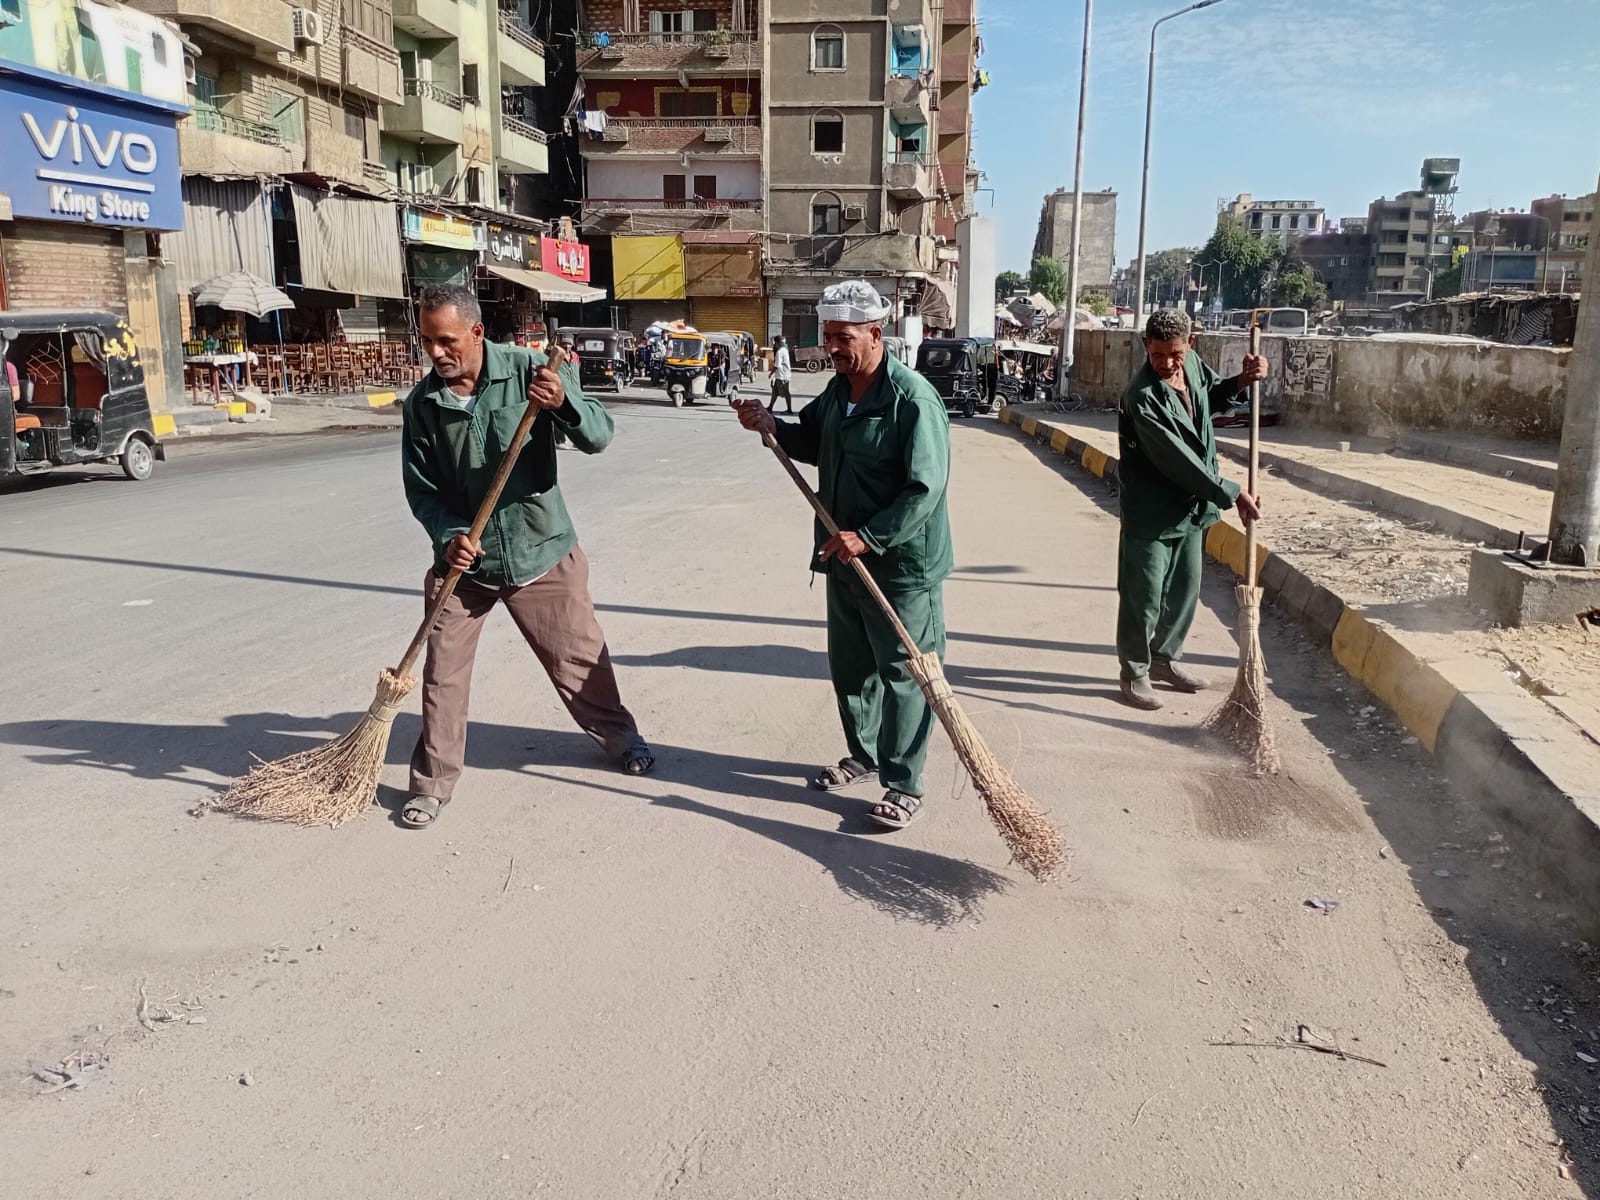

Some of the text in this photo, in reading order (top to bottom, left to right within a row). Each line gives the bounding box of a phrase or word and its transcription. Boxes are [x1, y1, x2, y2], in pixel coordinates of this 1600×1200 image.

[20, 106, 157, 174] vivo
[50, 185, 150, 220] King Store
